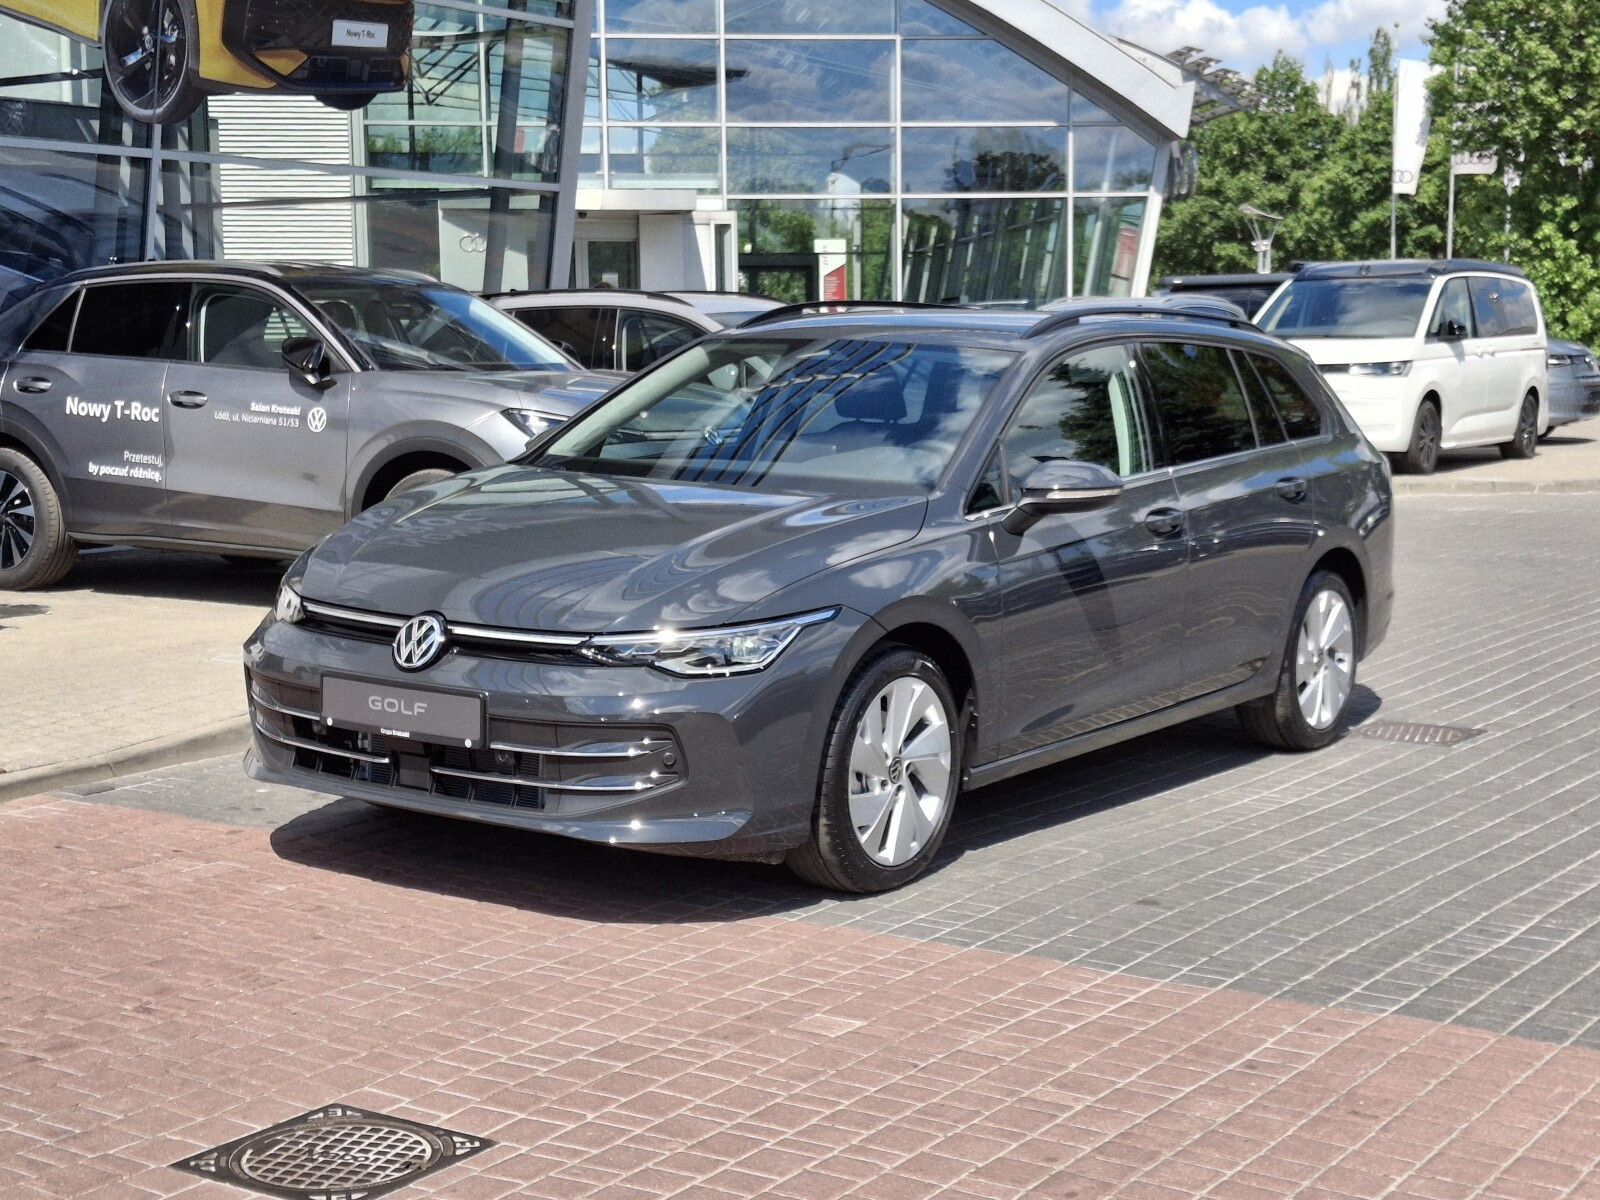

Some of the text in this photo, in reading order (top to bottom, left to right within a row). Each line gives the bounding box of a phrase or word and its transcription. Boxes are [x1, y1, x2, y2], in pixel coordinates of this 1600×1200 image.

[65, 396, 160, 422] Nowy T-Roc
[250, 402, 301, 416] Salon Krotoski
[278, 418, 299, 428] 51/53
[123, 450, 163, 468] Przetestuj,
[88, 461, 162, 483] by poczuć różnicę.
[368, 695, 428, 716] GOLF
